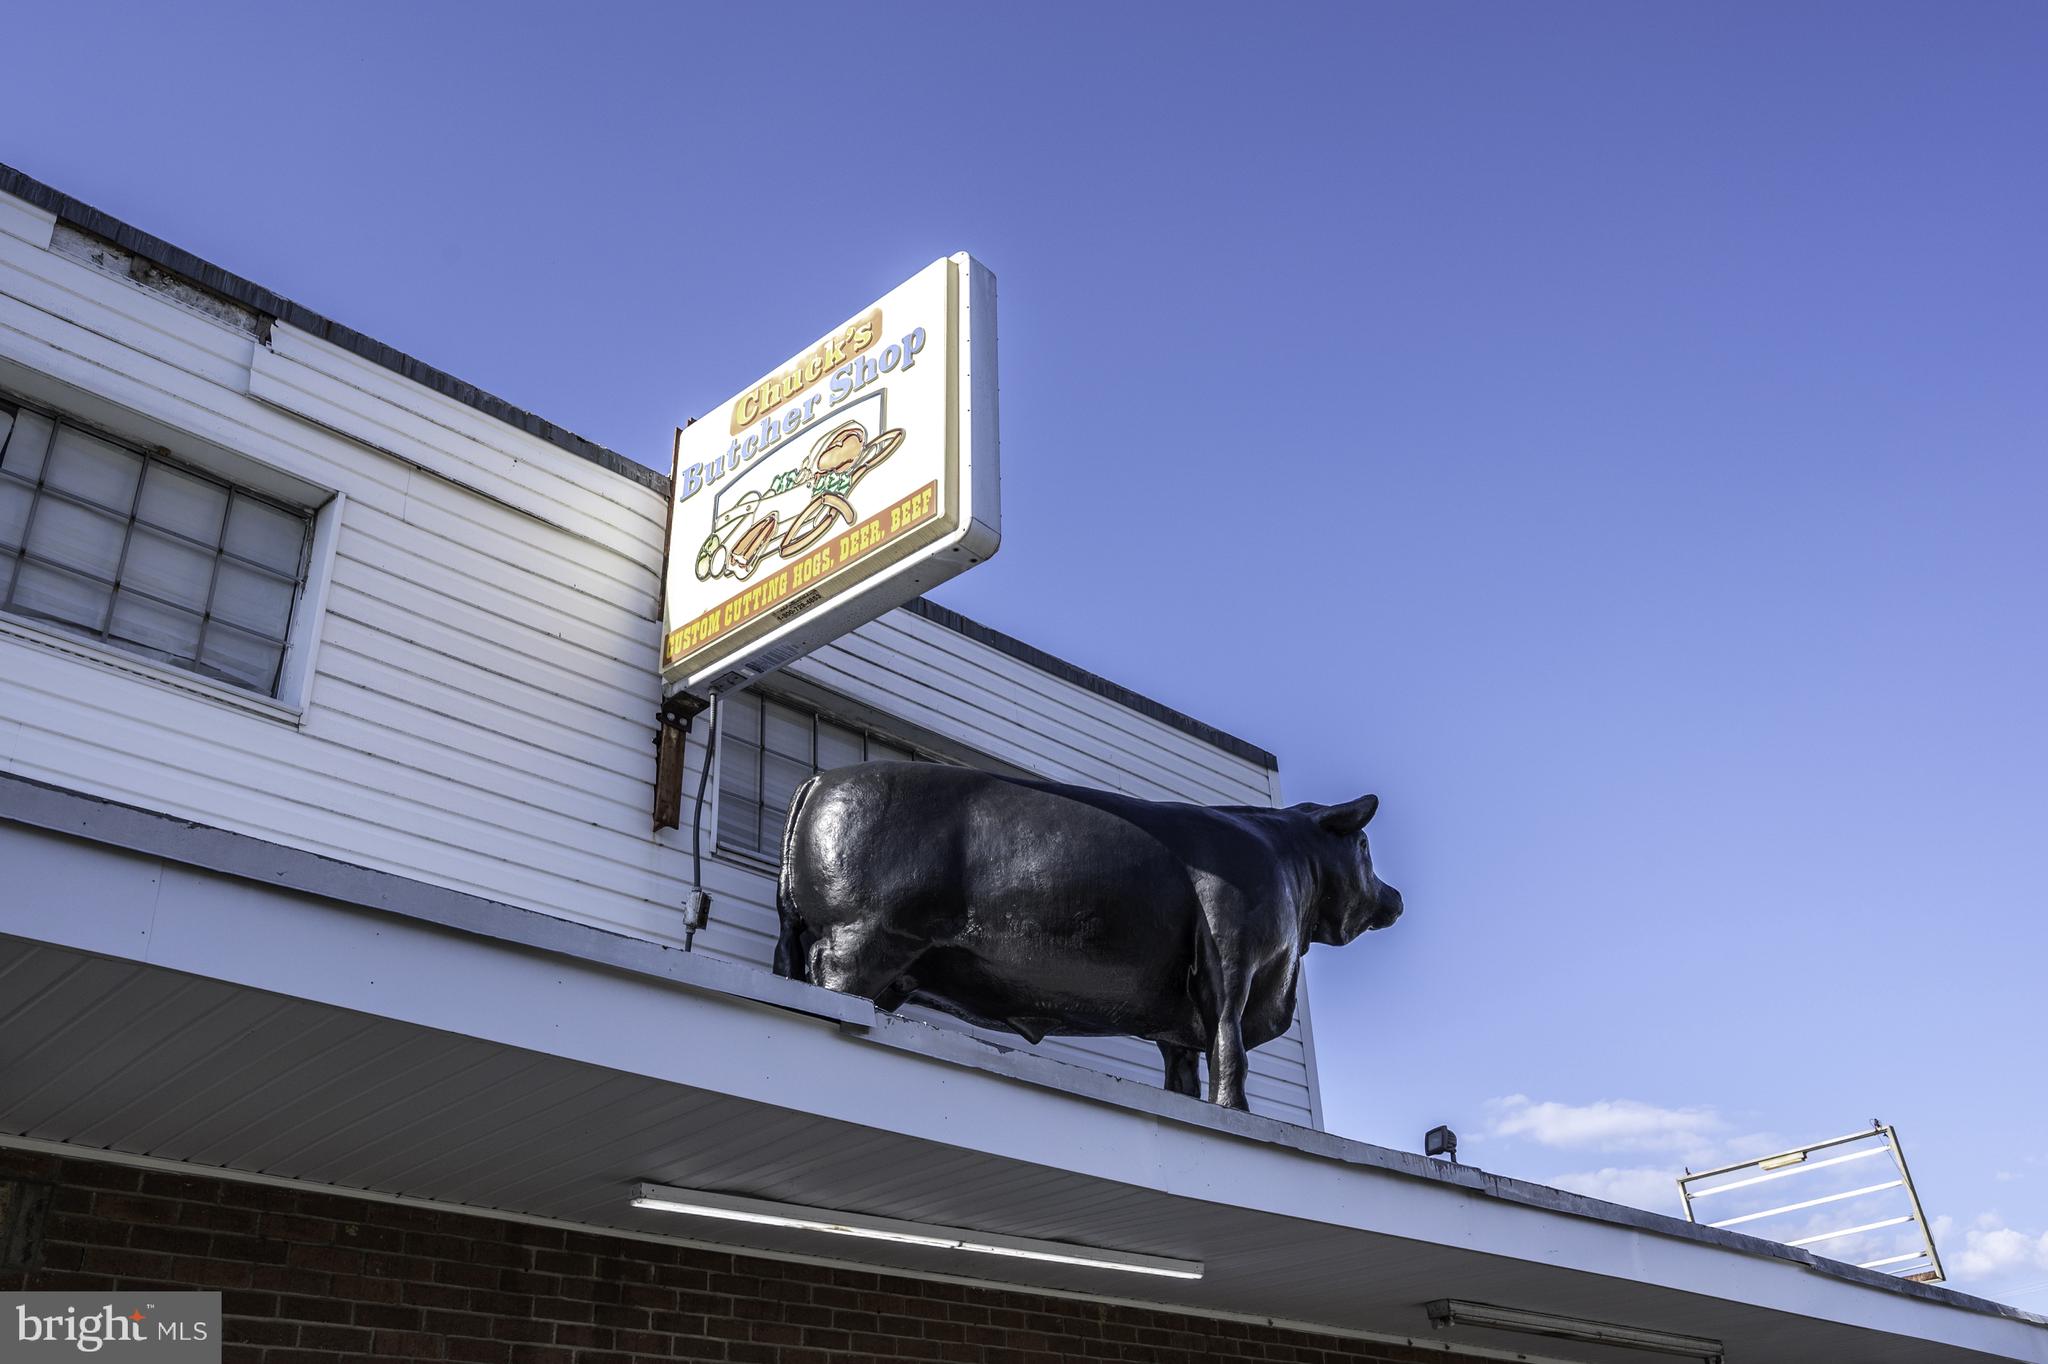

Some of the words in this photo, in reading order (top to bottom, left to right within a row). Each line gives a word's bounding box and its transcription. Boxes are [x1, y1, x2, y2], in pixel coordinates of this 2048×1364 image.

[680, 392, 822, 503] Butcher
[828, 327, 926, 407] Shop
[735, 321, 873, 427] Chuck's
[666, 609, 721, 658] CUSTOM
[724, 571, 788, 626] CUTTING
[792, 547, 834, 590] HOGS,
[840, 519, 885, 563] DEER,
[890, 487, 932, 533] BEEF
